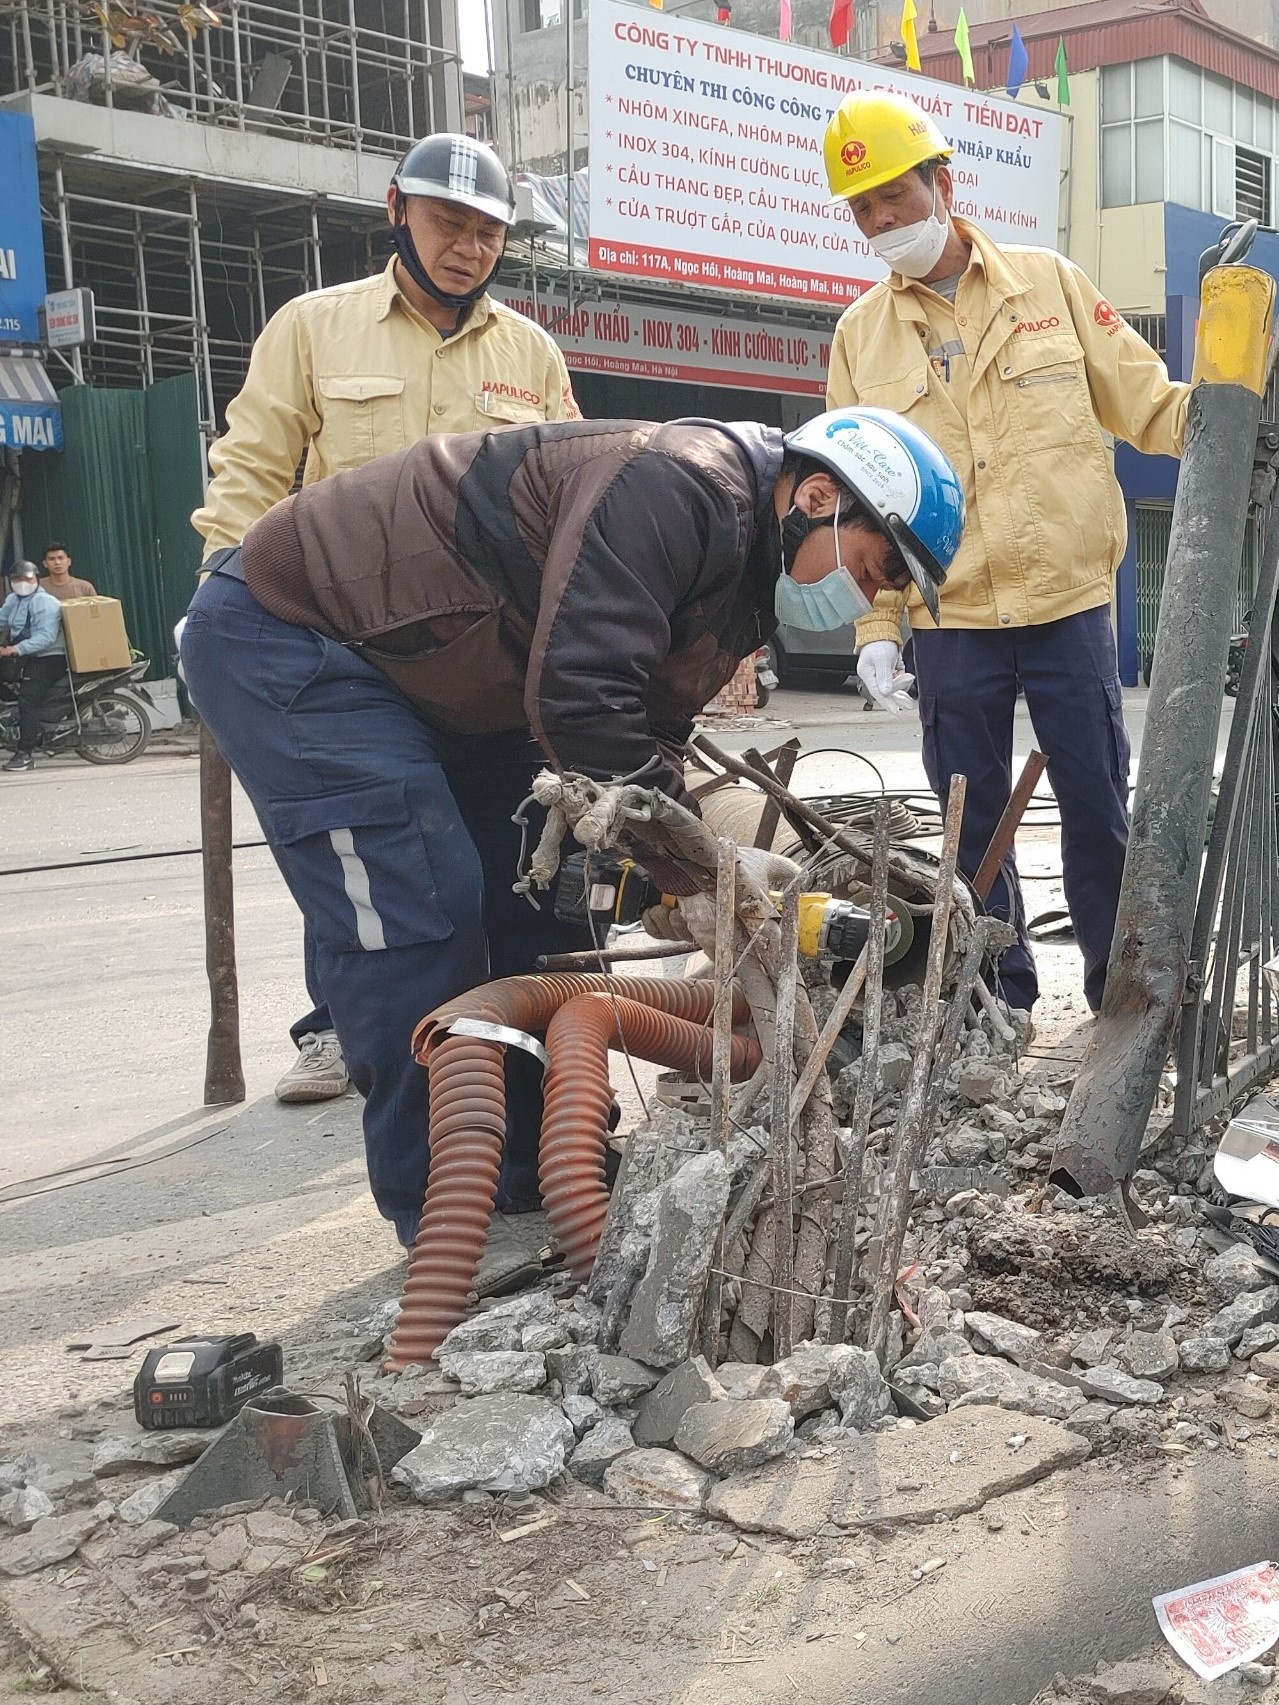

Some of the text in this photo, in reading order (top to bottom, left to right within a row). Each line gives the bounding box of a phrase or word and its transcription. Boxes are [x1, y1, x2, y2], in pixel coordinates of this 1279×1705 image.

[614, 21, 669, 50] CÔNG
[673, 35, 698, 57] TY
[702, 42, 751, 70] TNHH
[964, 100, 1003, 130] TIẾN
[1006, 114, 1044, 140] ĐẠT
[618, 97, 978, 188] NHÔM XINGFA, NHÔM PMA, LOẠI
[625, 64, 695, 94] CHUYÊN
[700, 80, 728, 101] THI
[732, 86, 776, 110] CÔNG
[780, 97, 822, 121] CÔNG
[957, 138, 993, 162] NHẬP
[996, 145, 1032, 168] KHẨU
[618, 133, 824, 189] INOX 304, KÍNH CƯỜNG LỰC,
[846, 161, 871, 177] HAPULICO
[618, 163, 650, 187] CẦU
[655, 173, 709, 198] THANG
[713, 184, 744, 206] ĐẸP,
[748, 187, 778, 210] CẦU
[781, 197, 830, 219] THANG
[984, 206, 1006, 223] MÁI
[1010, 210, 1038, 230] KÍNH
[618, 198, 650, 220] CỬA
[655, 206, 708, 230] TRƯỢT
[747, 220, 776, 241] CỬA
[780, 228, 818, 250] QUAY,
[822, 232, 850, 253] CỬA
[598, 246, 616, 264] Địa
[641, 252, 672, 272] 117A,
[674, 257, 700, 276] Ngọc
[724, 266, 754, 285] Hoàng
[756, 270, 777, 288] Mai,
[779, 274, 808, 292] Hoàng
[810, 278, 830, 296] Mai,
[832, 281, 844, 296] Hà
[846, 284, 860, 300] Nội
[594, 303, 630, 344] KHẨU
[643, 318, 673, 350] INOX
[676, 323, 700, 352] 304
[711, 324, 741, 358] KÍNH
[744, 328, 784, 363] CƯỜNG
[788, 338, 809, 372] LỰC
[1014, 316, 1060, 334] PULICO
[482, 381, 540, 405] HAPULICO
[632, 362, 650, 374] Mai,
[12, 414, 55, 446] MAI
